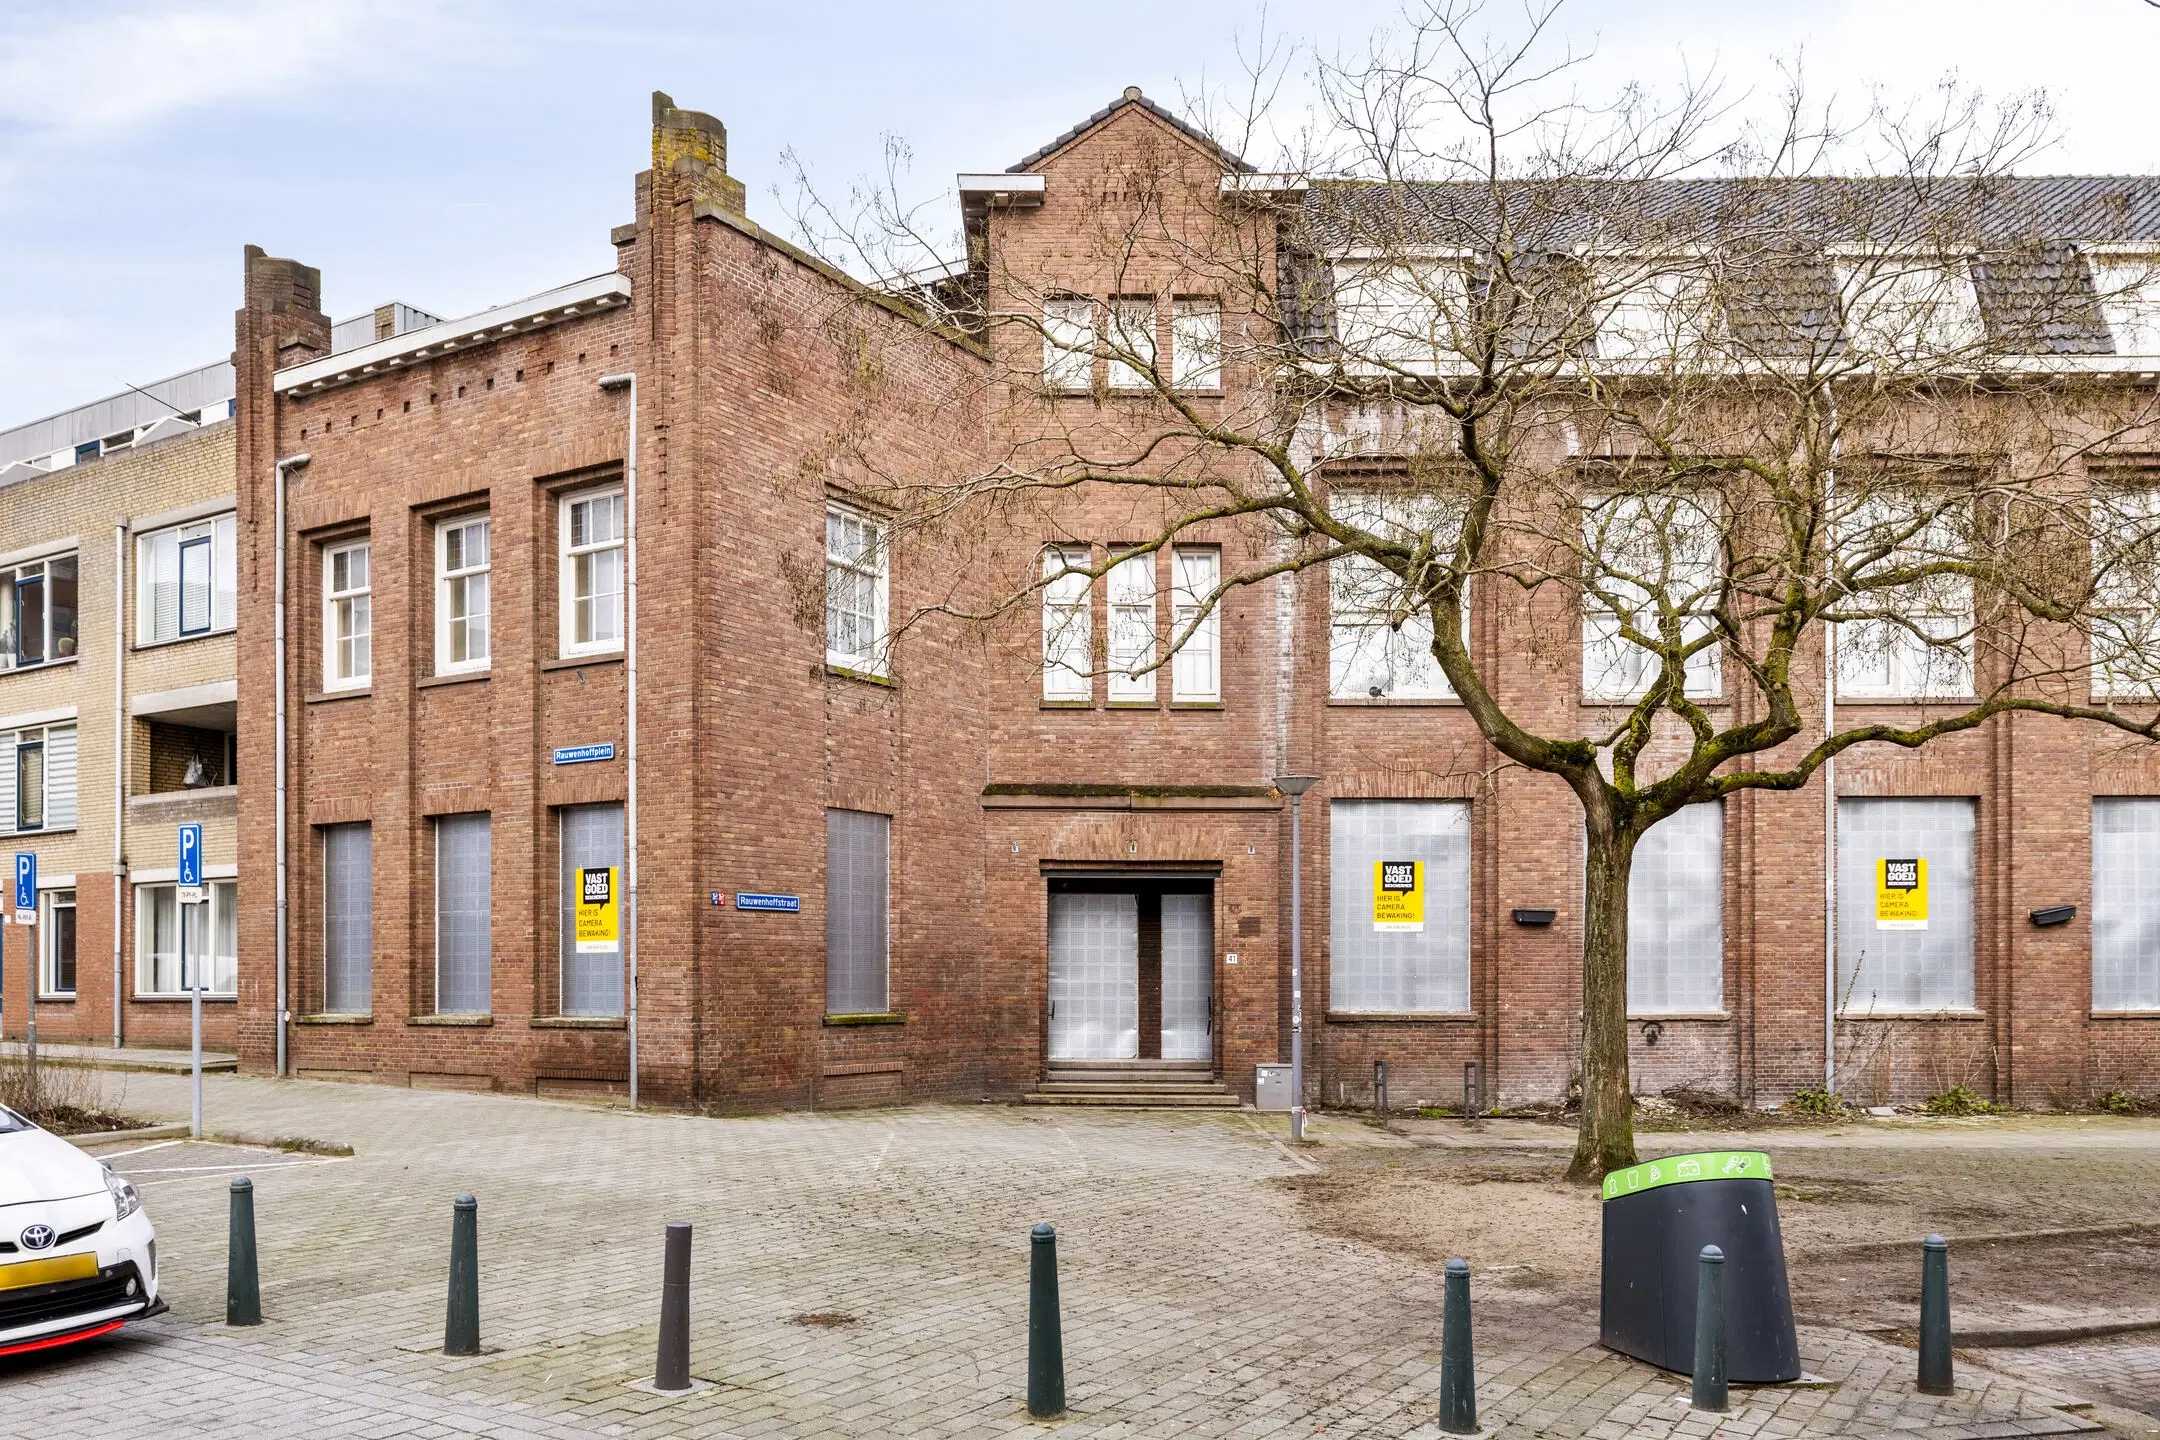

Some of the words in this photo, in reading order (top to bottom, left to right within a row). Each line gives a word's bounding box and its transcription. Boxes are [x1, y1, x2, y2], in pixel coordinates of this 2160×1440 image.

[556, 747, 611, 760] Rauwenhoffplein
[183, 829, 194, 860] P
[19, 857, 30, 885] P
[1384, 866, 1412, 875] VAST
[1888, 863, 1916, 873] VAST
[585, 873, 608, 884] VAST
[1384, 874, 1412, 883] GOED
[1887, 872, 1916, 881] GOED
[585, 883, 608, 895] GOED
[740, 896, 797, 908] Rauwenhoffstraat
[579, 909, 592, 917] HIER
[593, 908, 598, 916] IS
[579, 919, 602, 927] CAMERA
